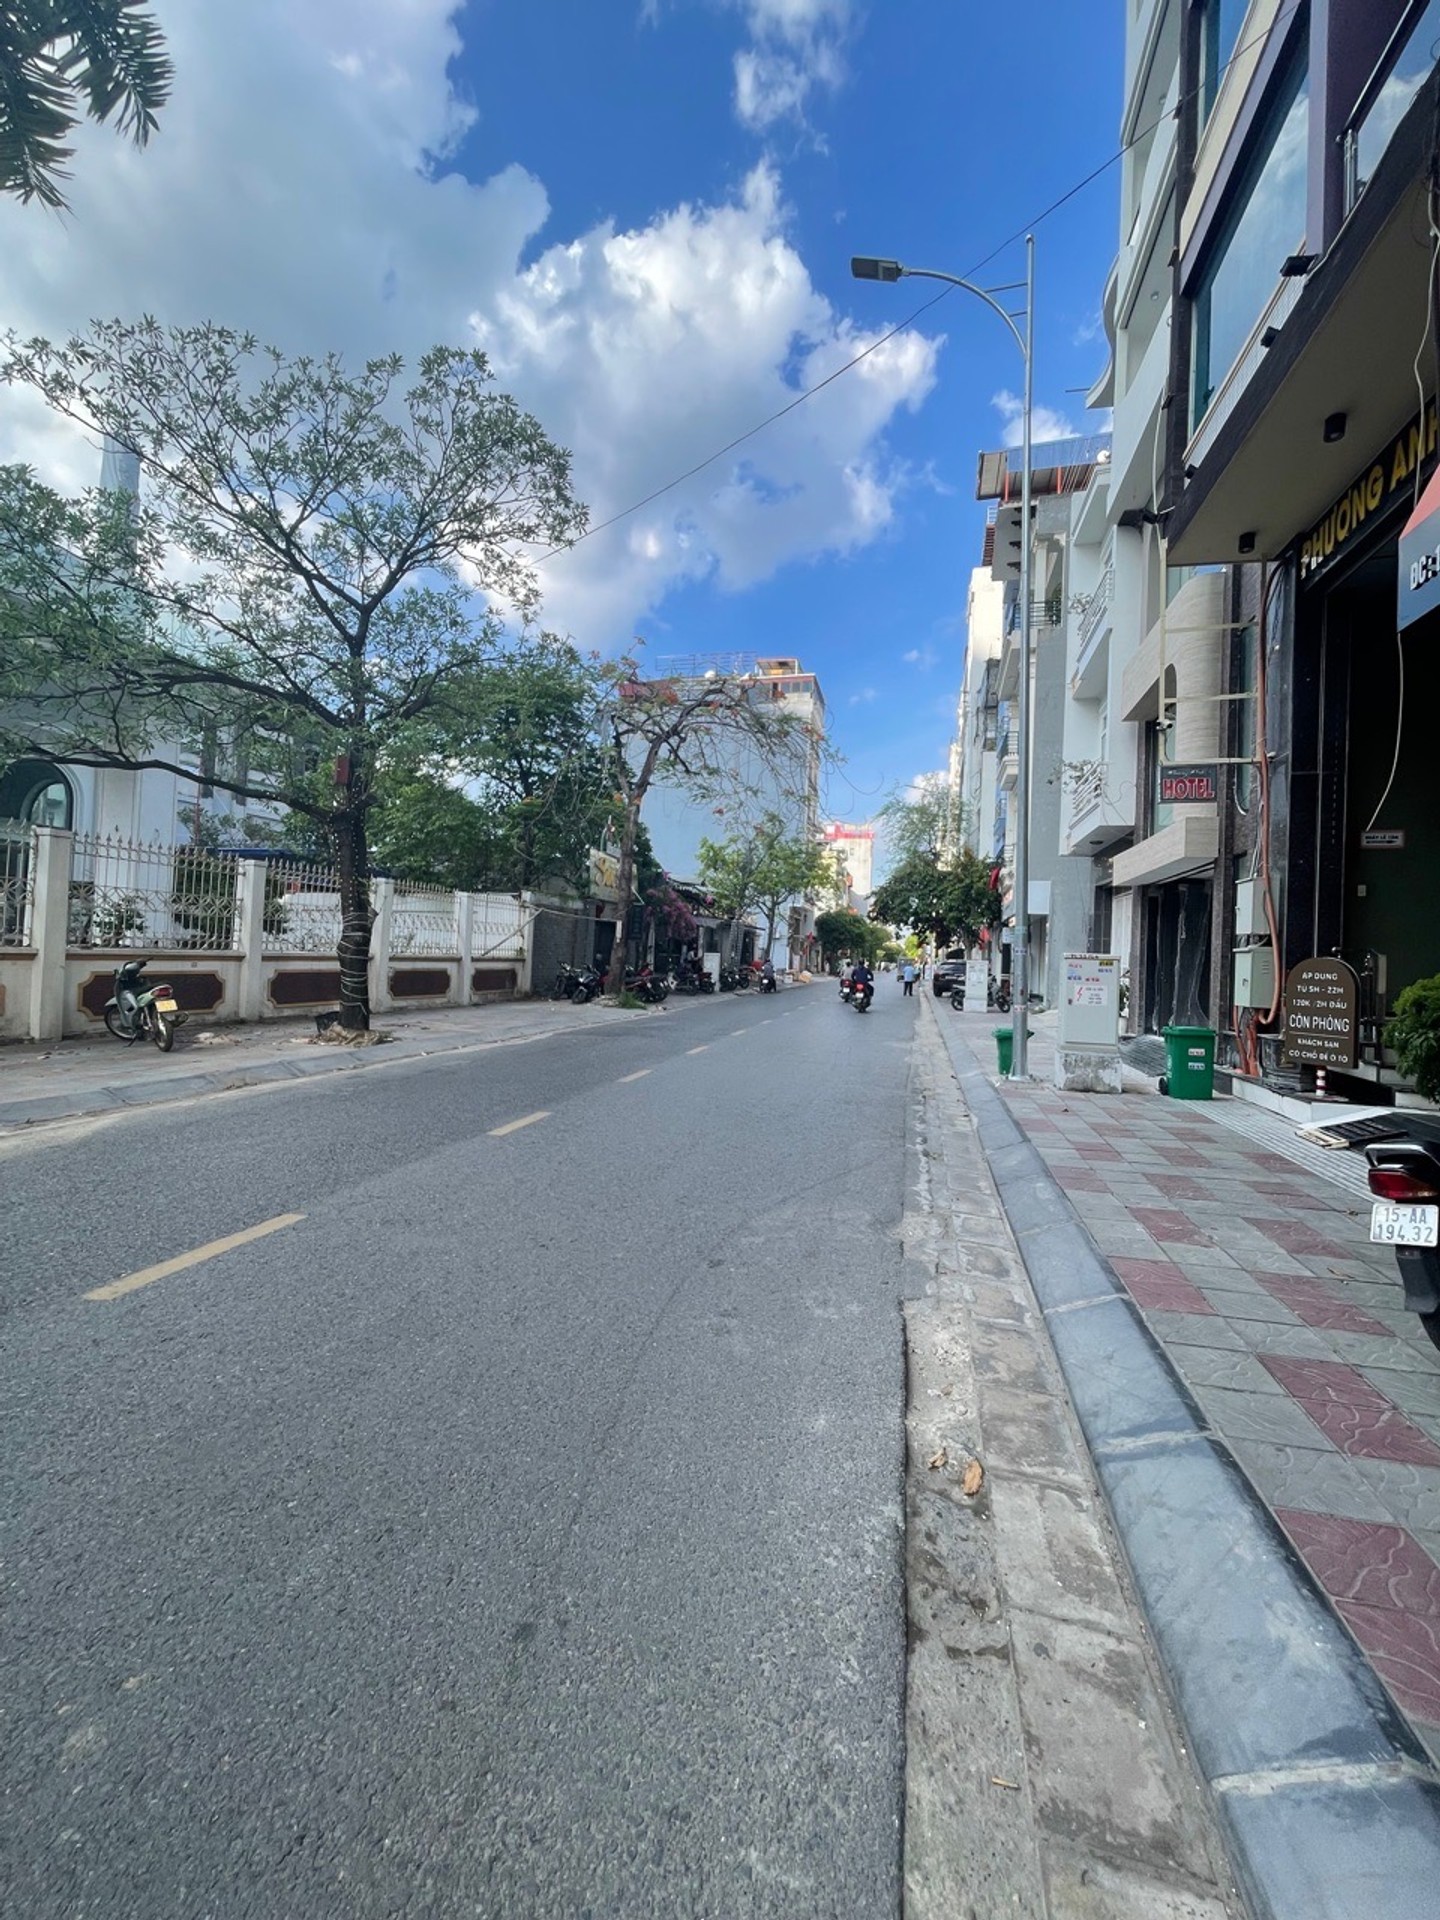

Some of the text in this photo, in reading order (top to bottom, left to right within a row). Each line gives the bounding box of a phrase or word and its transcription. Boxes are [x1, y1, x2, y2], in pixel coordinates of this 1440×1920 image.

[1162, 777, 1216, 799] HOTEL
[1384, 1207, 1427, 1224] 15-AA
[1377, 1224, 1433, 1243] 194.32
